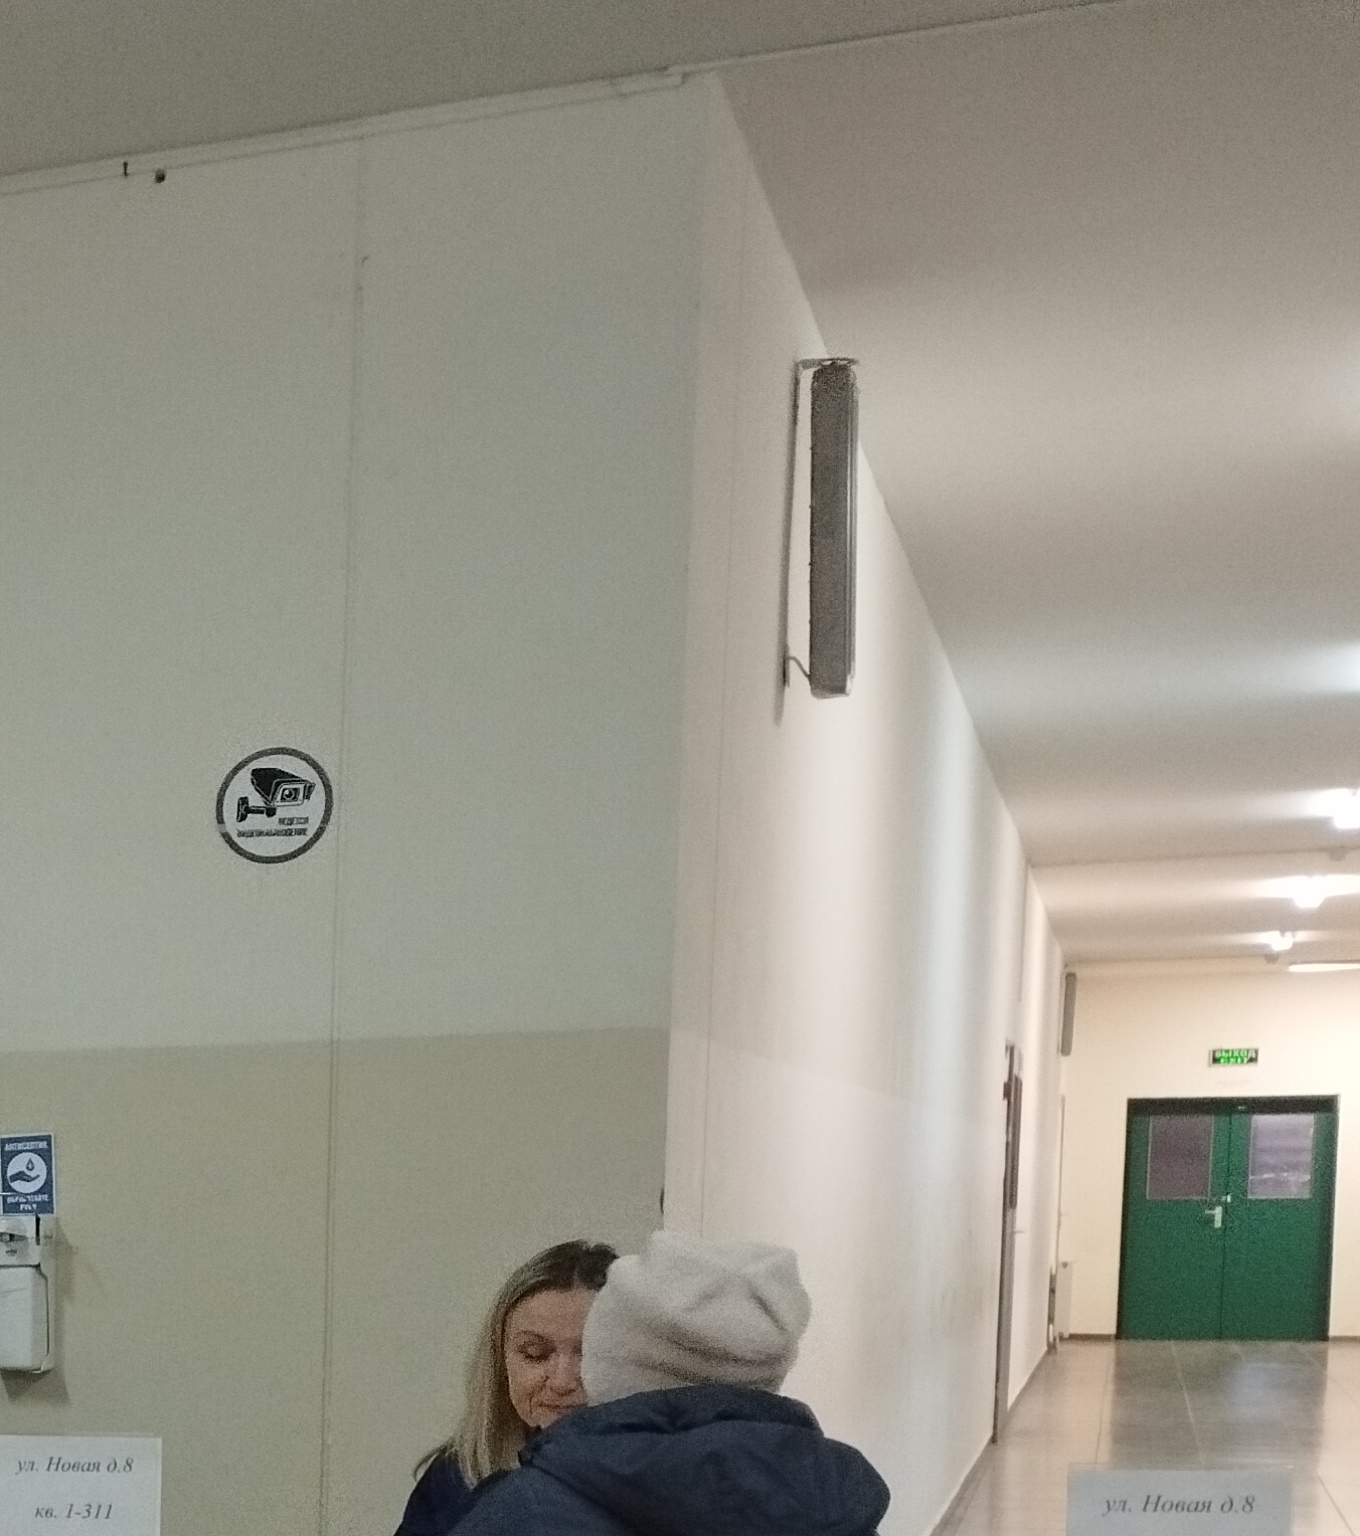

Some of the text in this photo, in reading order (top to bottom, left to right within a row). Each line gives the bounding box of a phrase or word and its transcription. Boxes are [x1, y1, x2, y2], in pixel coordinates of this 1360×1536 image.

[14, 1456, 134, 1476] ул. Новая д.8
[34, 1503, 113, 1520] кв. 1-311
[1101, 1494, 1256, 1517] ул. Новая д.8
